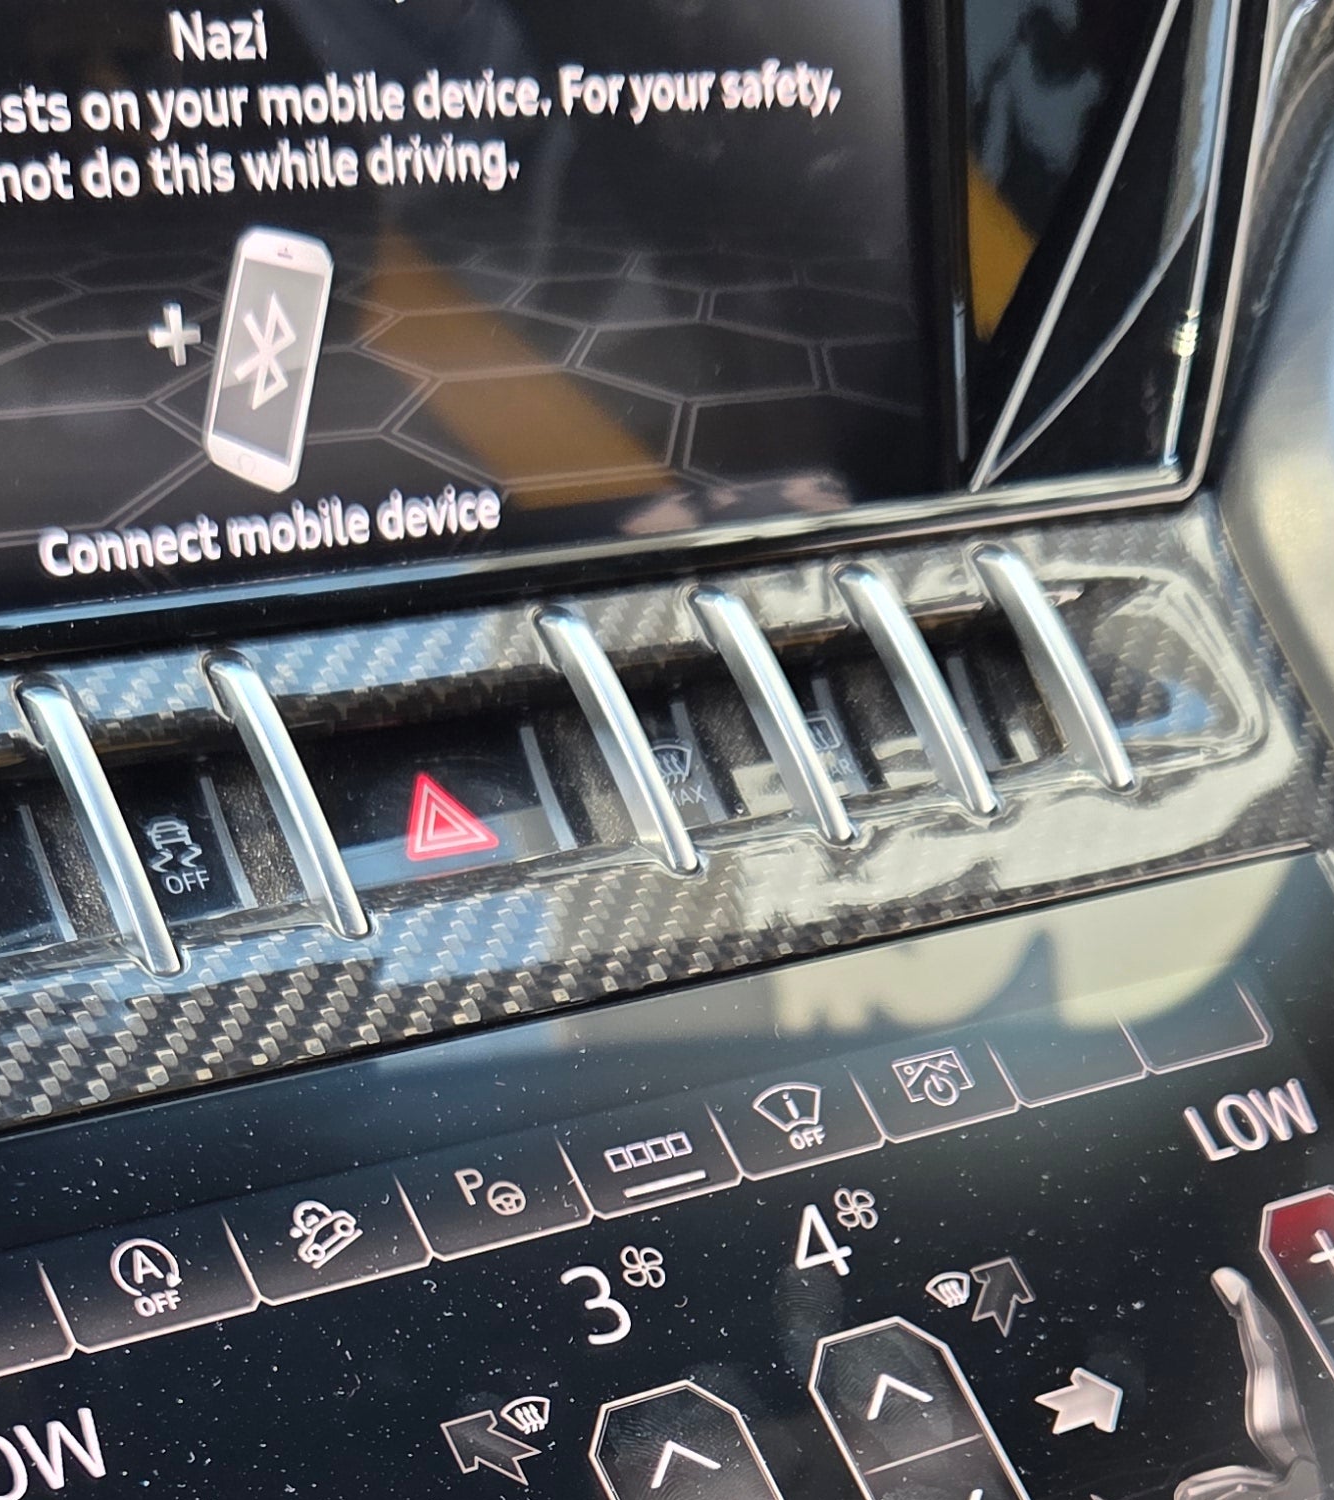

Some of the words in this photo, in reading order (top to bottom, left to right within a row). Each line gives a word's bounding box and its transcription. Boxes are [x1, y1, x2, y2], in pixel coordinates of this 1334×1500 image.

[169, 9, 267, 63] Nazi
[81, 87, 139, 134] on
[148, 85, 248, 141] your
[260, 70, 406, 125] mobile
[415, 68, 552, 120] device.
[559, 64, 624, 117] For
[629, 69, 715, 125] your
[721, 58, 842, 119] safety,
[81, 147, 141, 200] do
[148, 141, 235, 196] this
[246, 136, 359, 191] while
[366, 133, 521, 193] driving.
[39, 513, 222, 577] Connect
[226, 496, 370, 559] mobile
[377, 484, 502, 541] device
[165, 869, 210, 895] OFF
[789, 1124, 826, 1150] OFF
[1184, 1078, 1318, 1161] LOW
[454, 1168, 484, 1206] P
[133, 1249, 165, 1285] A
[795, 1204, 853, 1276] 4
[134, 1288, 182, 1317] OFF
[560, 1265, 632, 1345] 3
